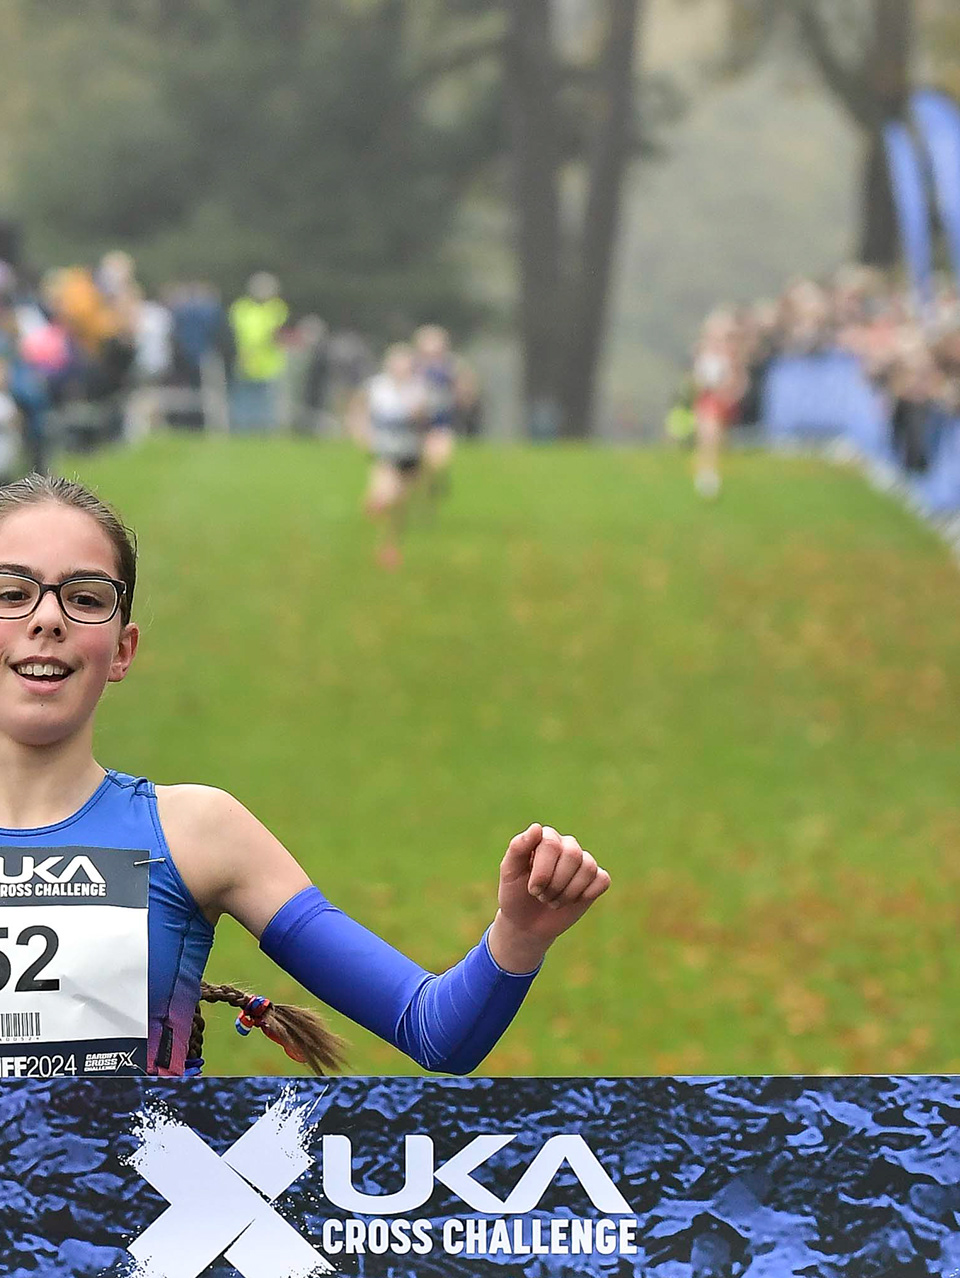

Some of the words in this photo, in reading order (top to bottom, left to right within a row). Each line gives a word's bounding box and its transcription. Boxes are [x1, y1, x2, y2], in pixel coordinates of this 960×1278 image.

[35, 883, 107, 897] CHALLENGE
[85, 1059, 118, 1067] CROSS
[86, 1052, 118, 1060] CARDIFF
[322, 1134, 635, 1215] UKA
[323, 1219, 434, 1255] CROSS
[443, 1219, 638, 1255] CHALLENGE
